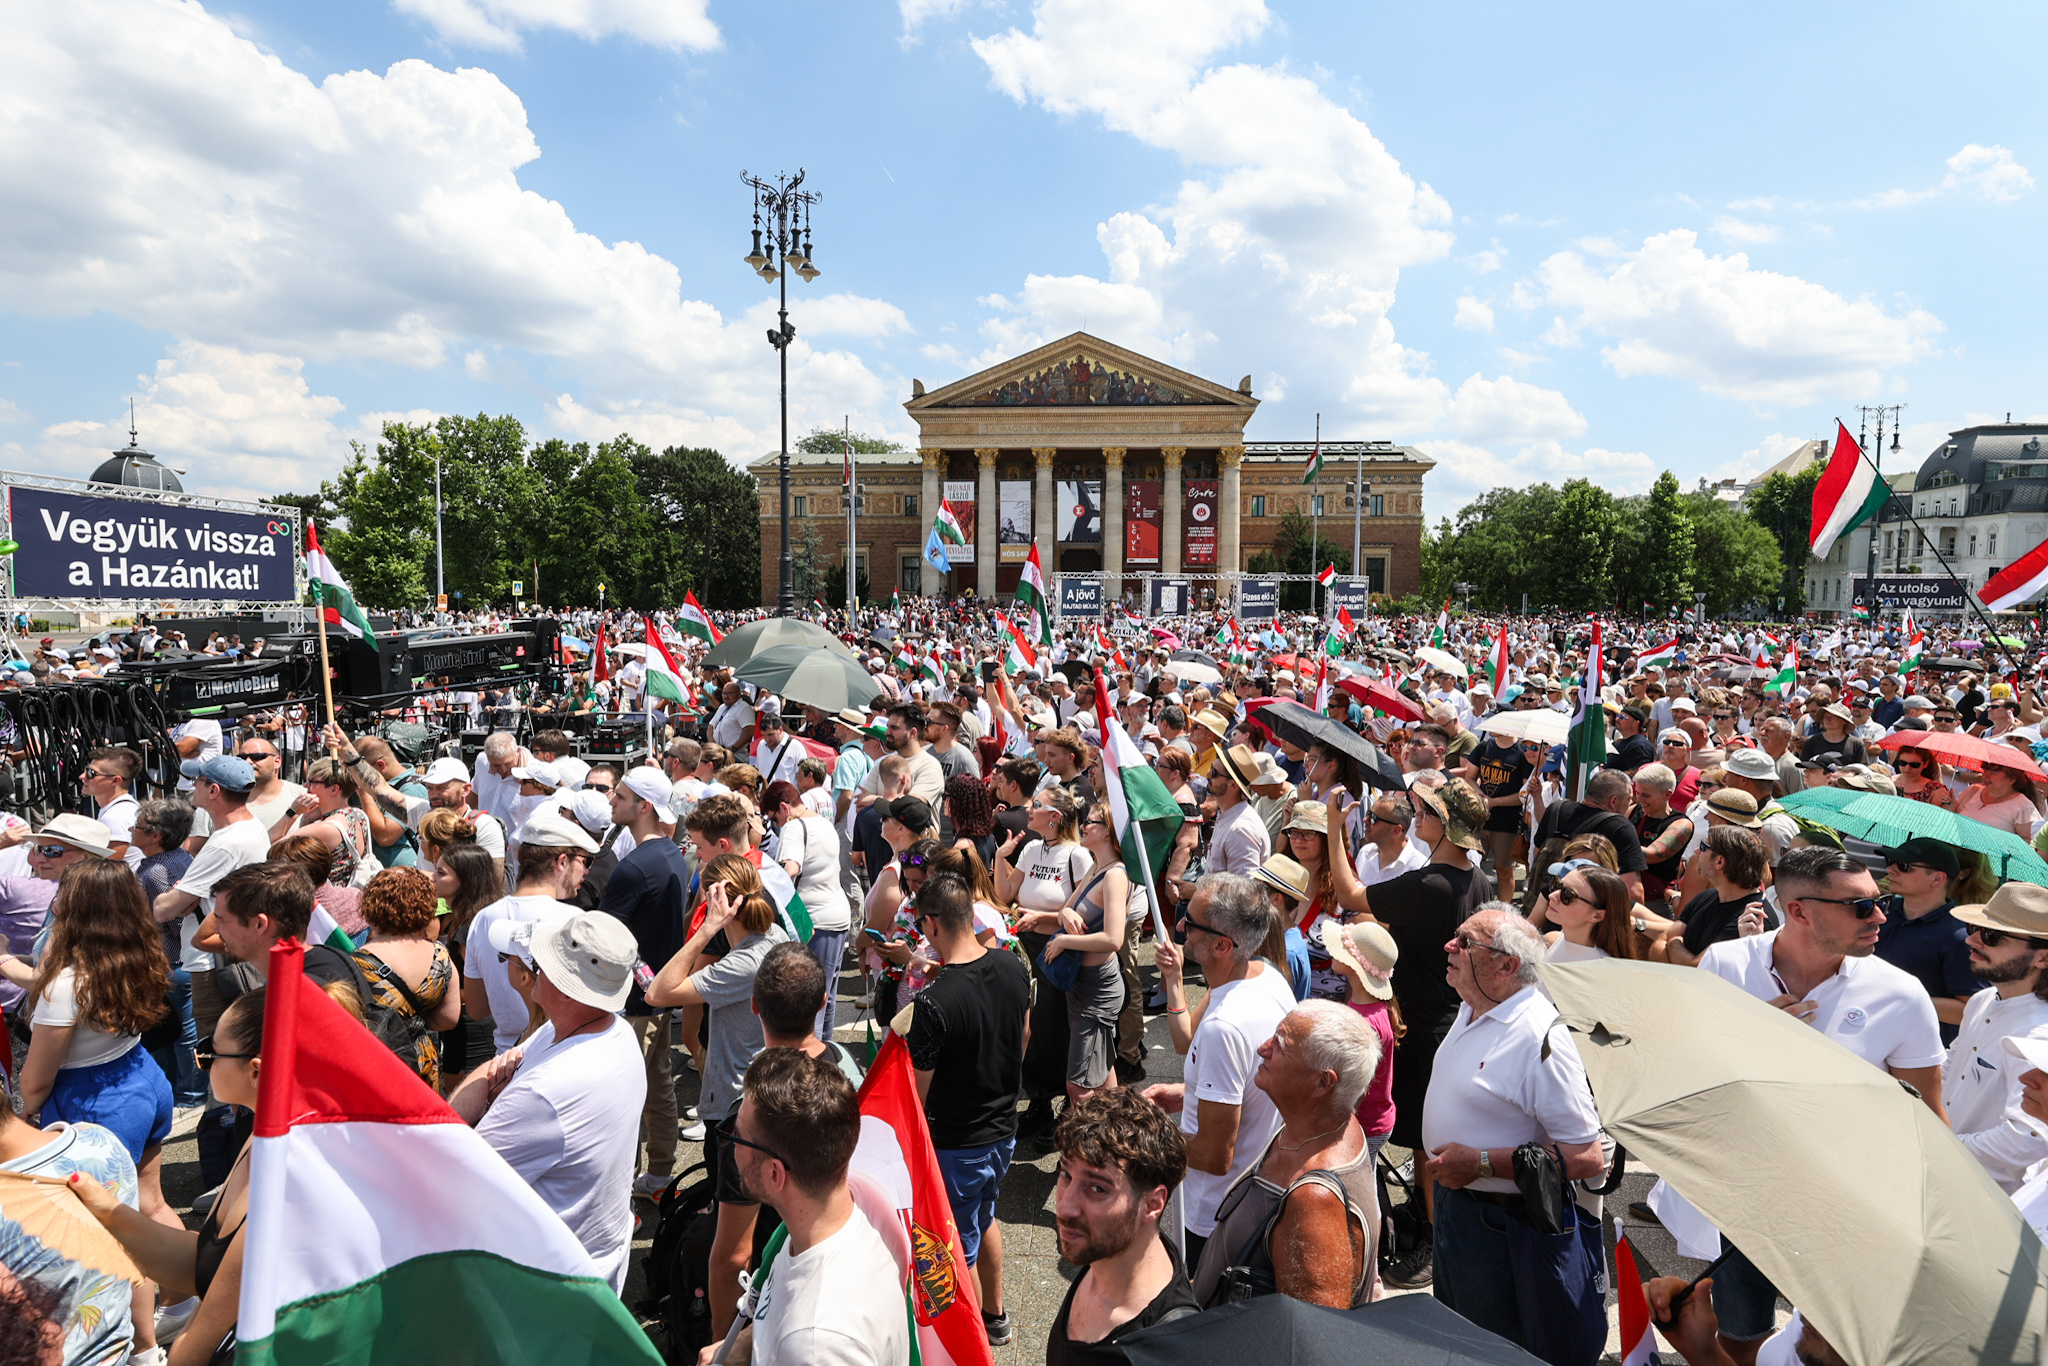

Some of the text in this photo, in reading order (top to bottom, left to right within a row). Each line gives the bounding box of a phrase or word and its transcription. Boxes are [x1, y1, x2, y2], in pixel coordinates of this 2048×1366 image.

[948, 483, 971, 492] MOLNÁR
[949, 491, 969, 500] LÁSZLÓ
[40, 508, 276, 556] Vegyük vissza
[1002, 549, 1016, 558] KÓS
[68, 556, 260, 590] a Hazánkat!
[1878, 583, 1939, 594] Az utolsó
[1066, 588, 1096, 602] A jövő
[1242, 592, 1261, 601] Fizess
[1902, 595, 1962, 608] vagyunk!
[424, 648, 485, 671] MovieBird
[211, 674, 279, 696] MovieBird
[1480, 764, 1511, 784] HAWAII
[1031, 864, 1062, 874] FUTURE
[1034, 872, 1052, 880] MILF
